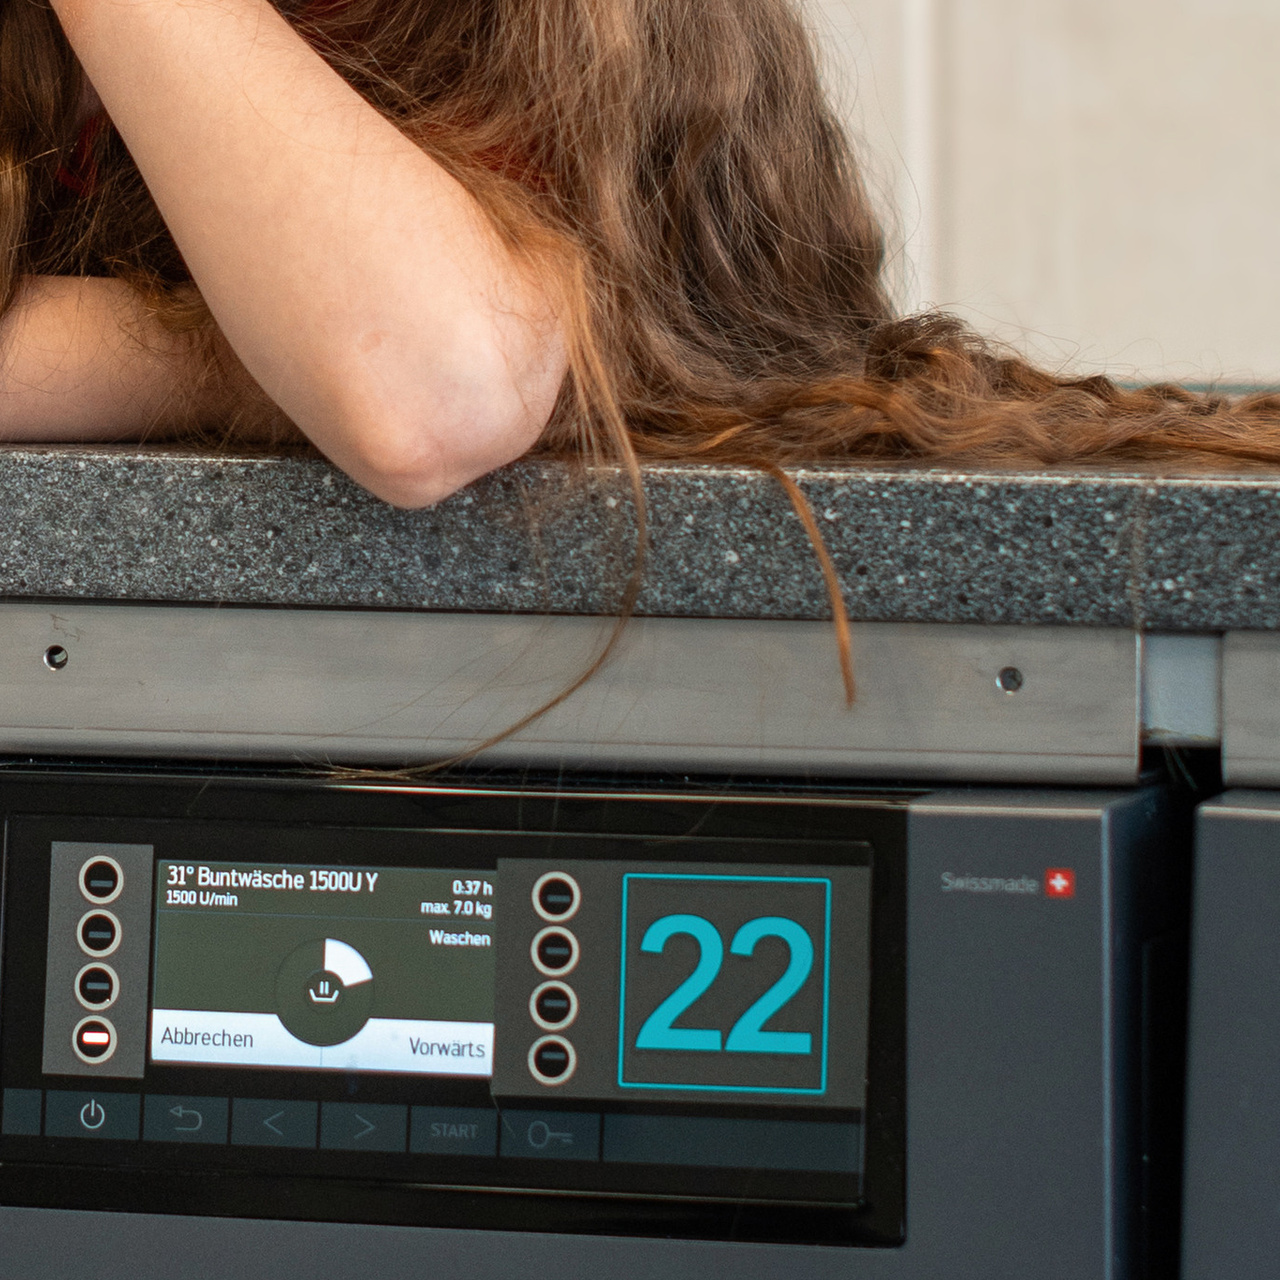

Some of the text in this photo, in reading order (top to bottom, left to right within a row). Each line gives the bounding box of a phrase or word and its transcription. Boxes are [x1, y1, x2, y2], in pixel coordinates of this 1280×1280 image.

[198, 866, 305, 890] Buntwäsche
[482, 880, 493, 896] h
[167, 890, 238, 906] 1500 U/min
[453, 900, 474, 916] 7.0
[475, 901, 493, 920] kg
[428, 929, 492, 947] Waschen
[635, 913, 814, 1054] 22
[160, 1026, 254, 1048] Abbrechen
[409, 1036, 486, 1058] Vorwärts
[429, 1122, 479, 1139] START
